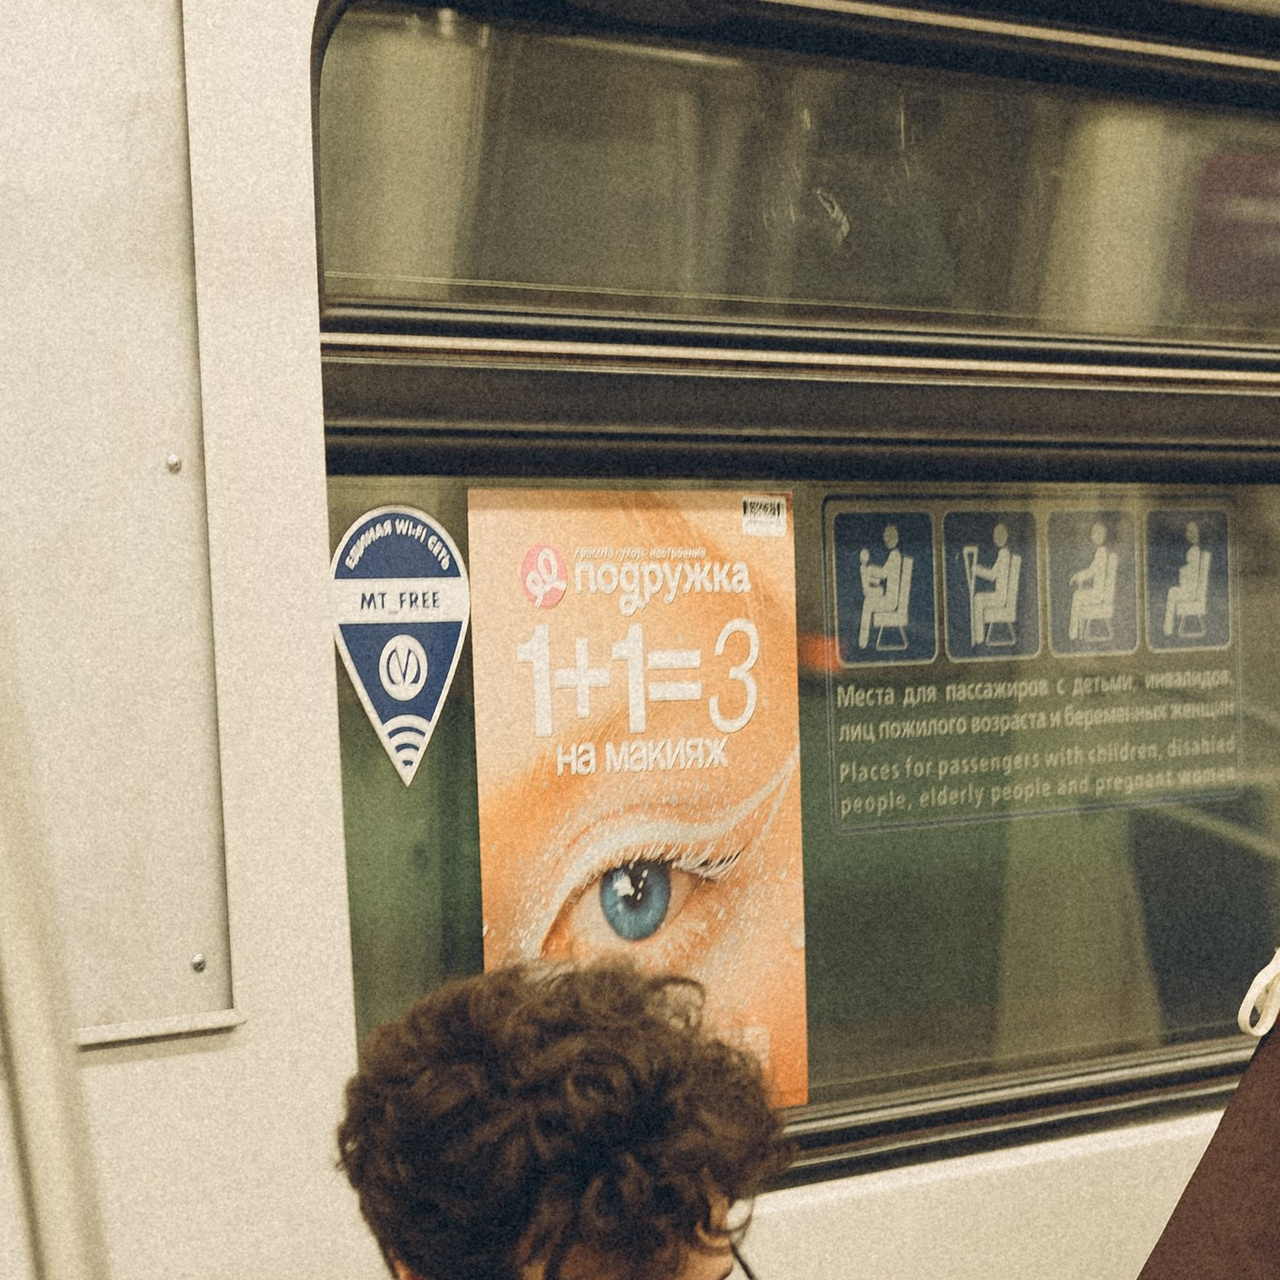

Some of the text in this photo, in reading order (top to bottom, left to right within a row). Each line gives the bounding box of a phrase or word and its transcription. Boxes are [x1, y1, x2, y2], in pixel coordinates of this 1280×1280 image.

[344, 518, 450, 571] ЕДИНАЯ WI-FI СЕТЬ
[573, 560, 751, 617] подружка
[516, 618, 760, 738] 1+1=3
[836, 684, 896, 709] Места
[902, 685, 938, 708] для
[945, 678, 1050, 704] пассажиров
[1056, 678, 1066, 696] с
[838, 700, 1236, 744] лиц пожилого возраста и беременных женщин
[555, 735, 730, 776] на макияж
[838, 760, 900, 784] Places
[904, 755, 933, 779] for
[937, 752, 1040, 781] passengers
[1044, 744, 1084, 768] with
[1166, 735, 1236, 759] disabled
[840, 767, 1236, 821] people, elderly people and pregnant women
